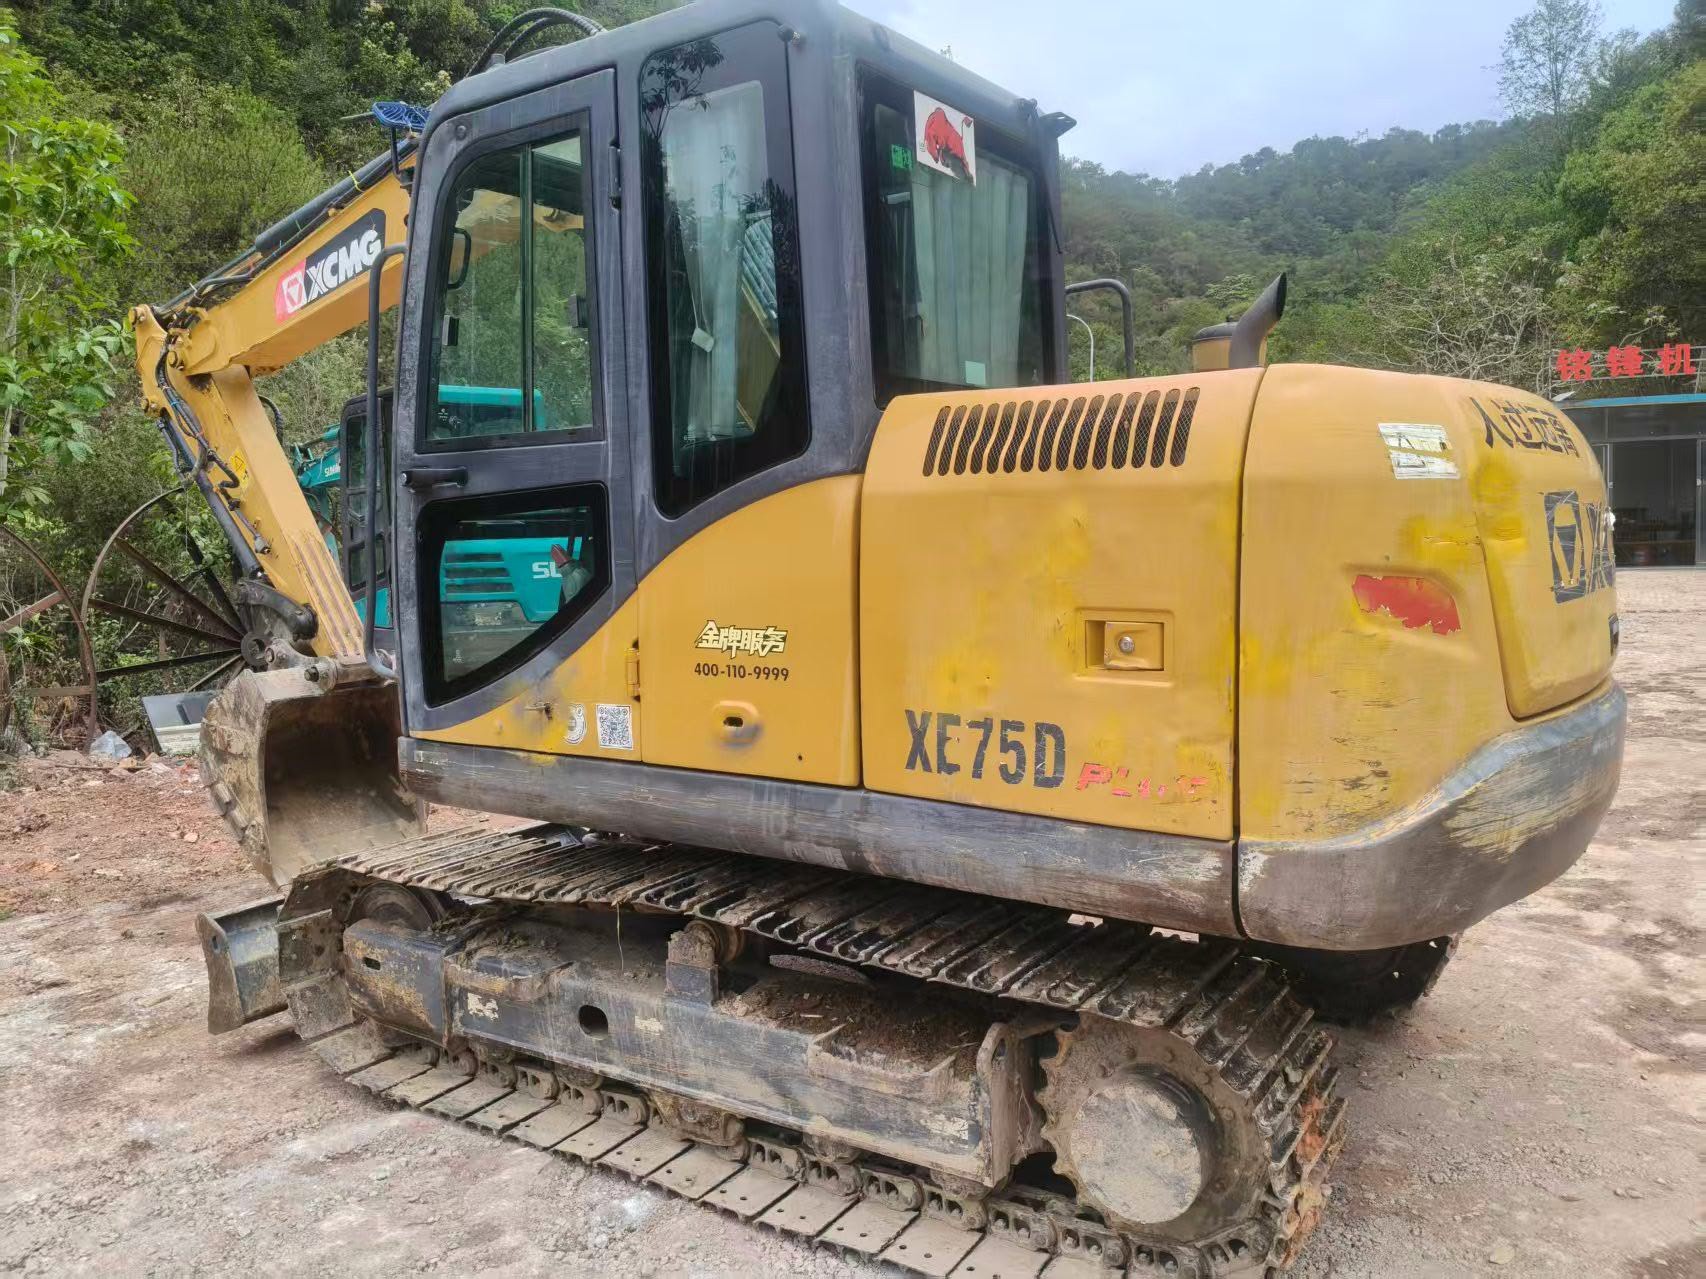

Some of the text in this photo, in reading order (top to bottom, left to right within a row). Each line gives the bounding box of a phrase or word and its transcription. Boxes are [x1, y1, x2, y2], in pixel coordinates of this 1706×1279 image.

[306, 229, 382, 303] XCMG
[694, 619, 788, 659] 金牌服务
[694, 662, 790, 682] 400-110-9999
[904, 709, 1066, 788] XE75D
